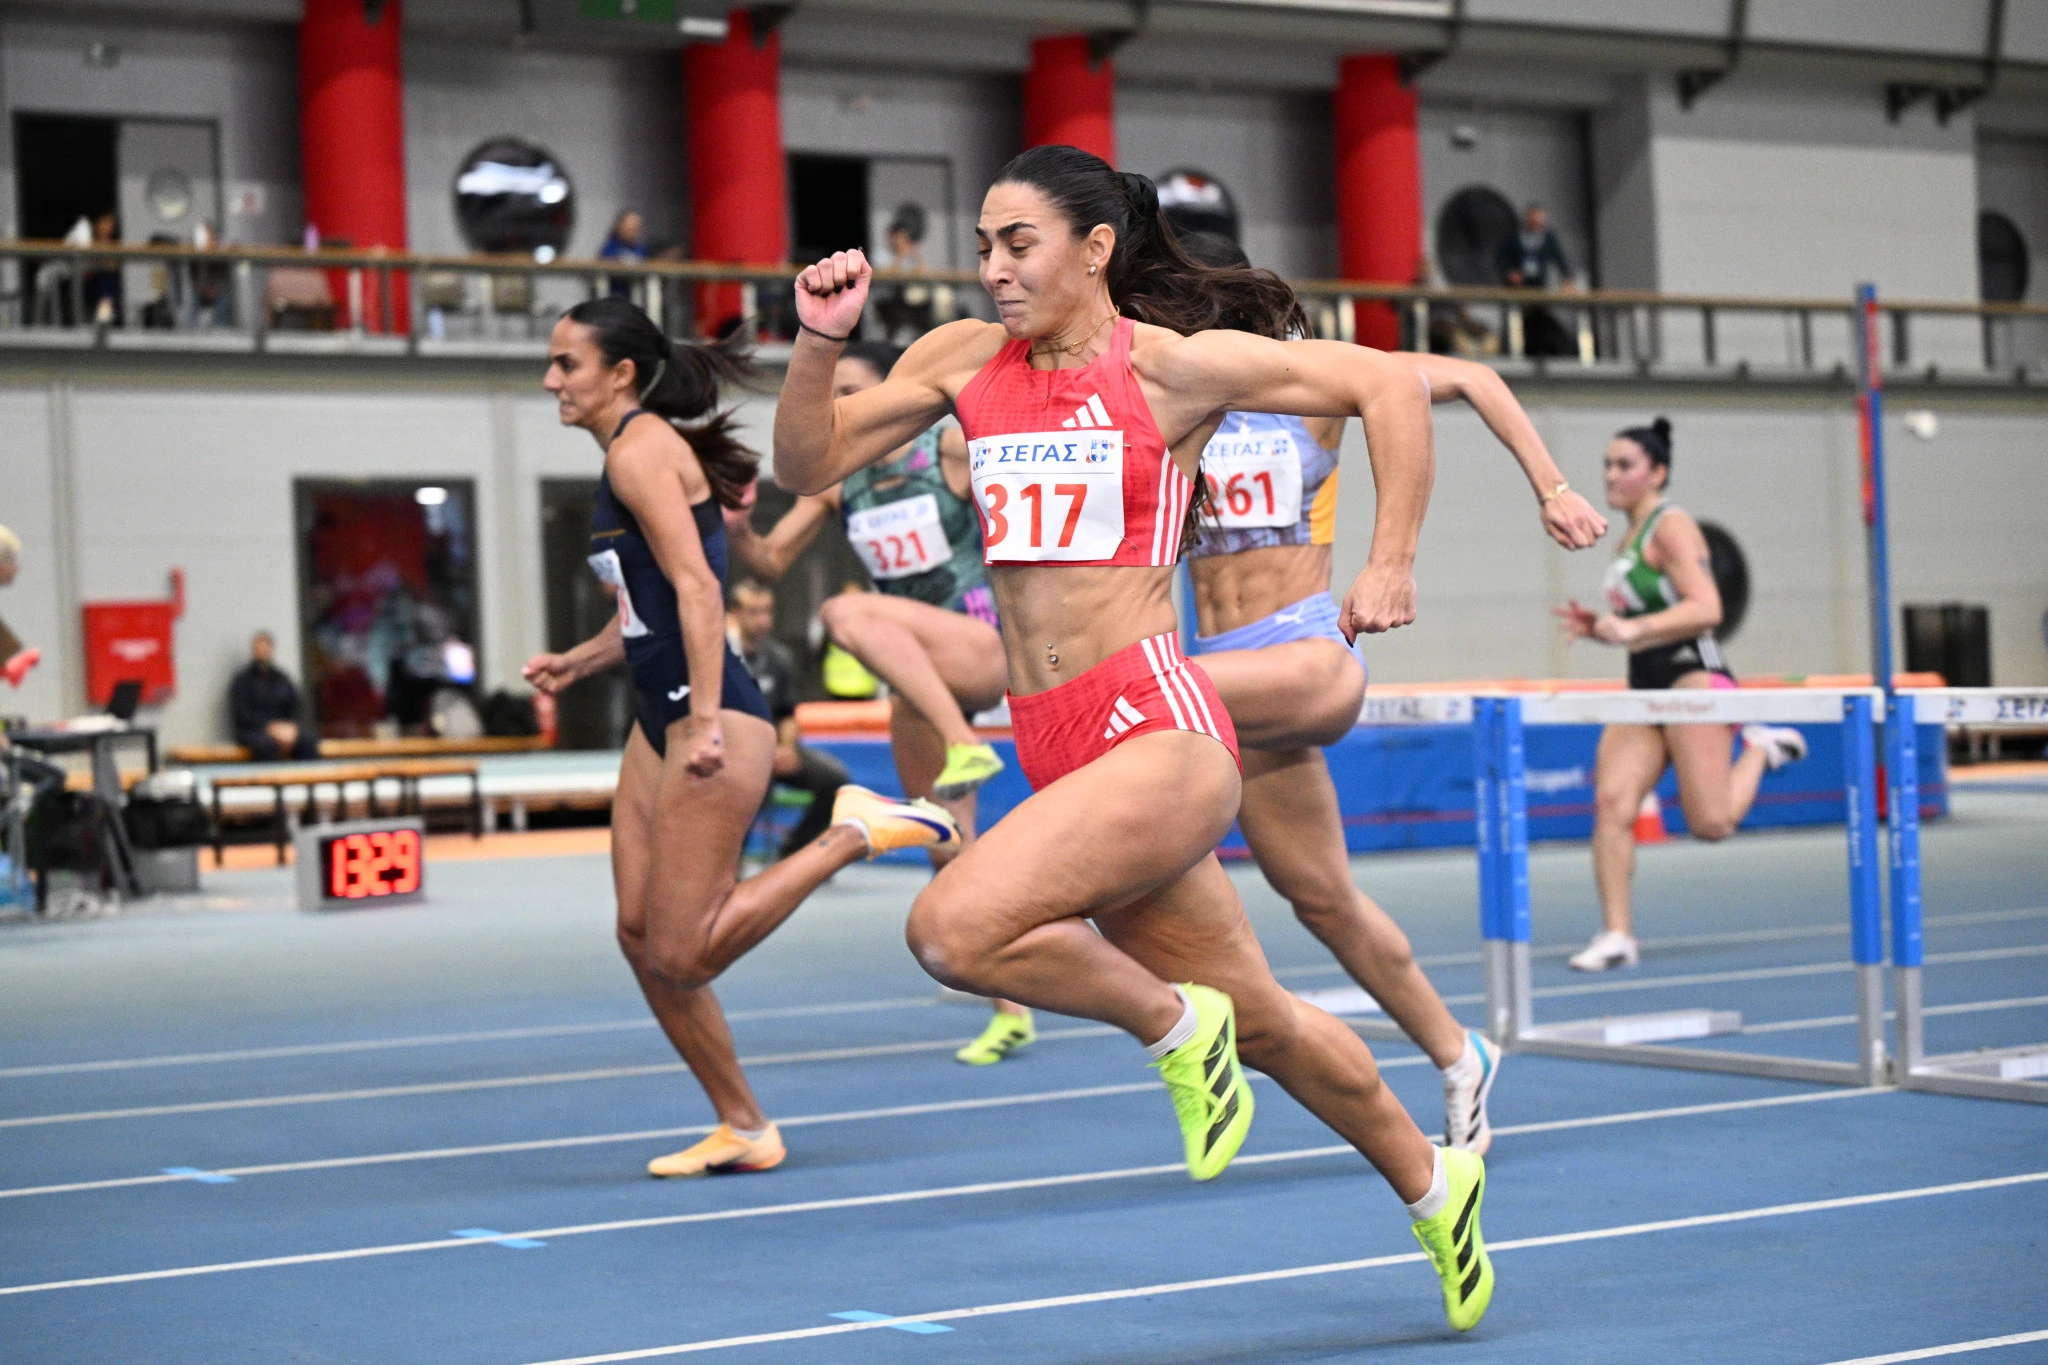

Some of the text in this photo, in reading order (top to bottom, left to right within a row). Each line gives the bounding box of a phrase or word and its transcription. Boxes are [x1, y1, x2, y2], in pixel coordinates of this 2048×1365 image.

[998, 443, 1078, 463] ΣΕΓΑΣ
[1207, 442, 1265, 457] ΣΕΓΑΣ
[1202, 471, 1275, 516] 261
[985, 483, 1088, 548] 317
[867, 530, 929, 571] 321
